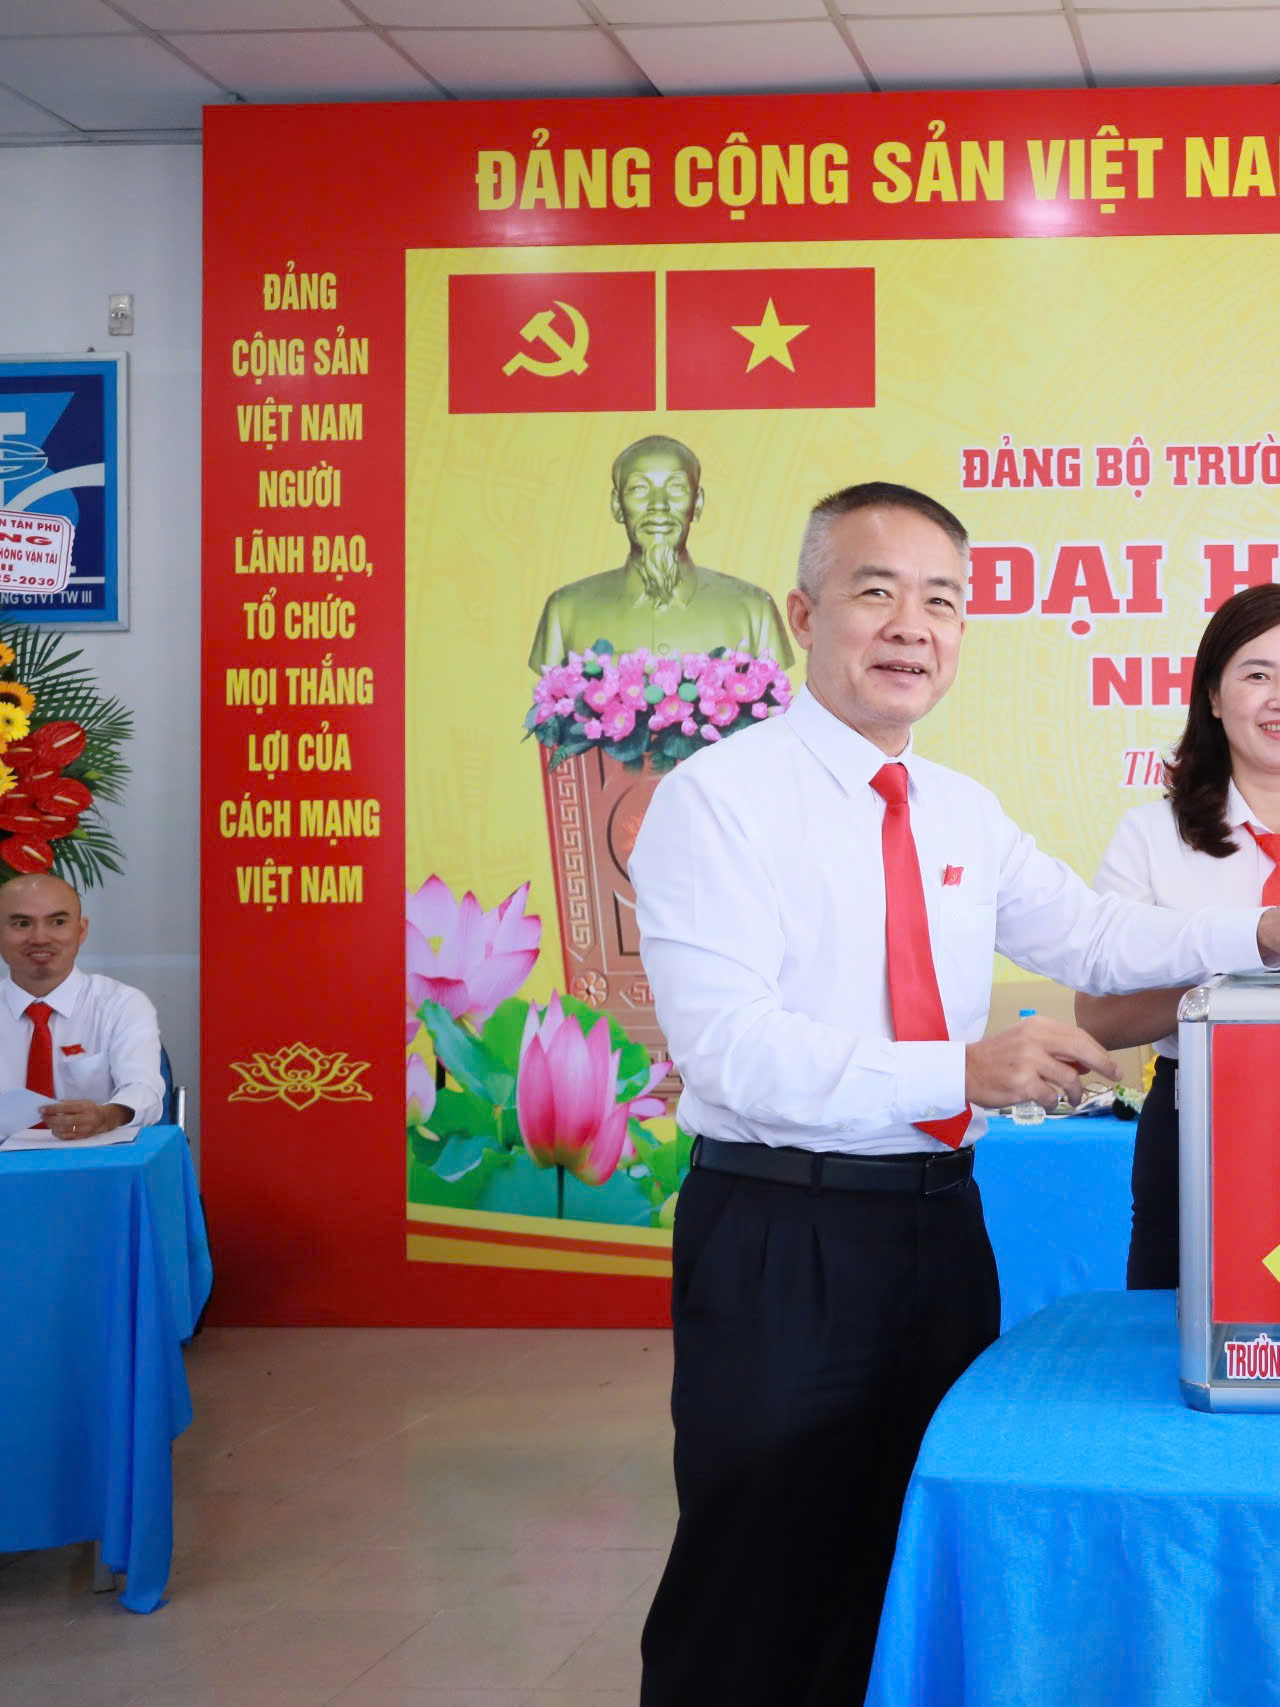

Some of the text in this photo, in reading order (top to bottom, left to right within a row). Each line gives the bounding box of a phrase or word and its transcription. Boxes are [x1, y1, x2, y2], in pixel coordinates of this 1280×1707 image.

[476, 128, 650, 210] ĐẢNG
[675, 133, 848, 220] CỘNG
[873, 120, 1004, 203] SẢN
[1028, 125, 1163, 213] VIỆT
[264, 262, 336, 310] ĐẢNG
[233, 327, 368, 384] CỘNG SẢN
[237, 397, 362, 448] VIỆT NAM
[260, 462, 340, 507] NGƯỜI
[963, 436, 1080, 488] ĐẢNG
[1096, 437, 1150, 498] BỘ
[236, 529, 372, 581] LÃNH ĐẠO,
[244, 588, 355, 639] TỔ CHỨC
[964, 545, 1163, 635] ĐẠI
[227, 655, 373, 713] MỌI THẮNG
[249, 721, 351, 779] LỢI CỦA
[221, 793, 380, 845] CÁCH MẠNG
[237, 859, 362, 911] VIỆT NAM
